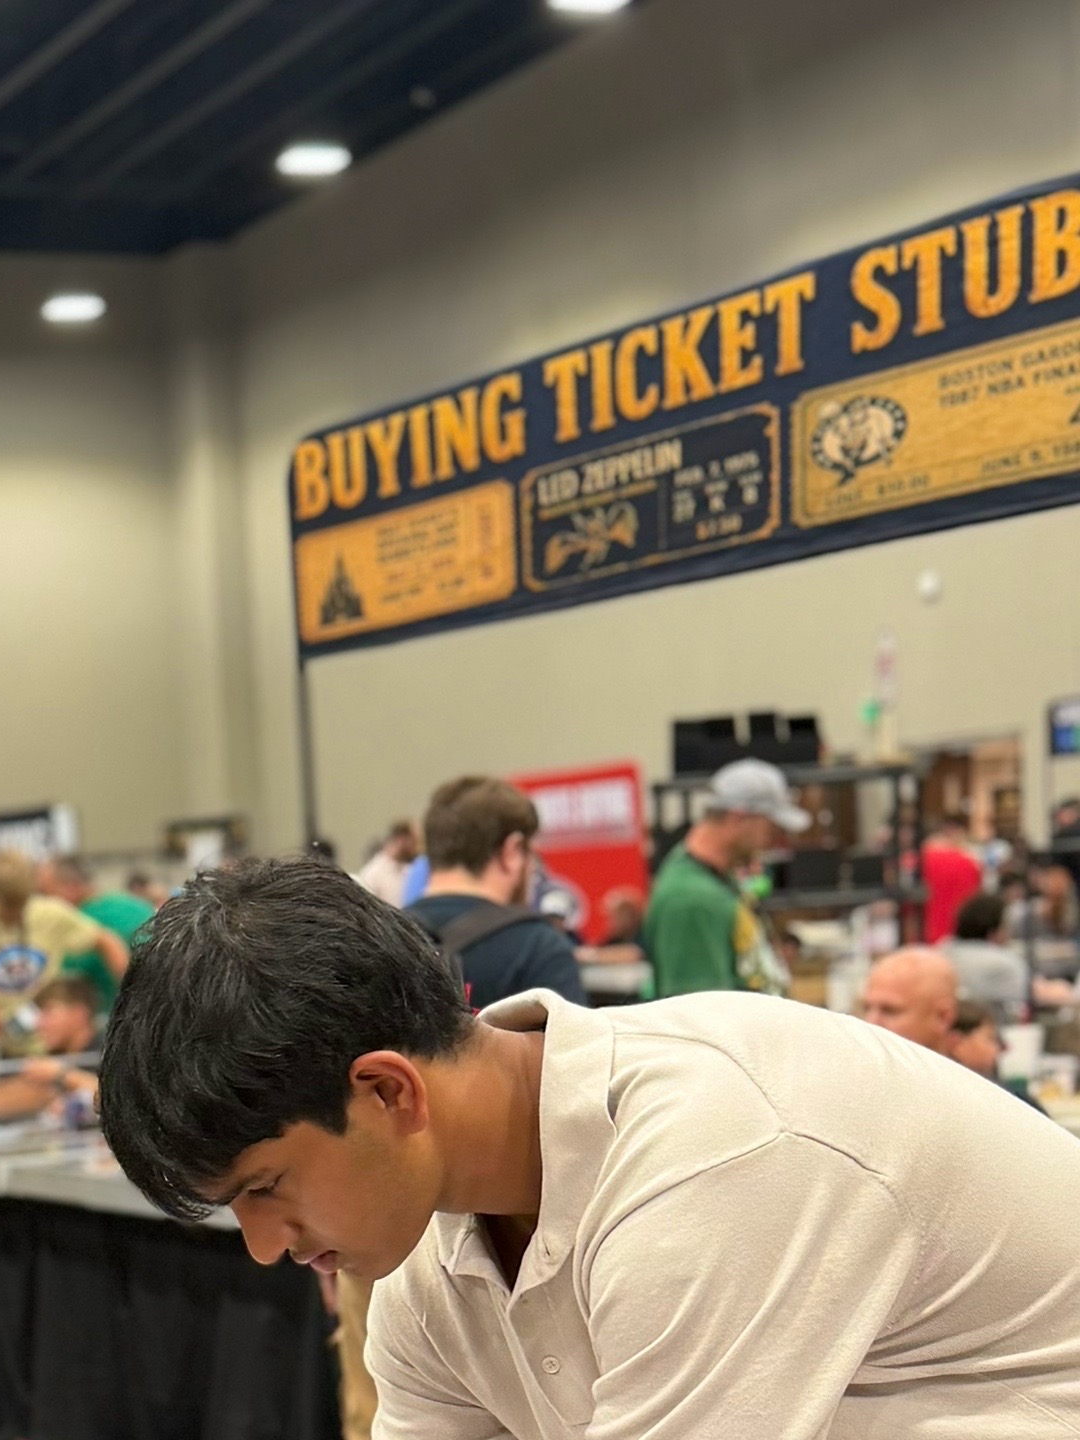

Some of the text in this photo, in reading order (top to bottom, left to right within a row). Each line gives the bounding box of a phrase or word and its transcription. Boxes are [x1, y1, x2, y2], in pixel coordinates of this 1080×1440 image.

[294, 373, 527, 522] BUYING
[542, 271, 817, 443] TICKET
[537, 438, 683, 507] LED ZEPPELIN
